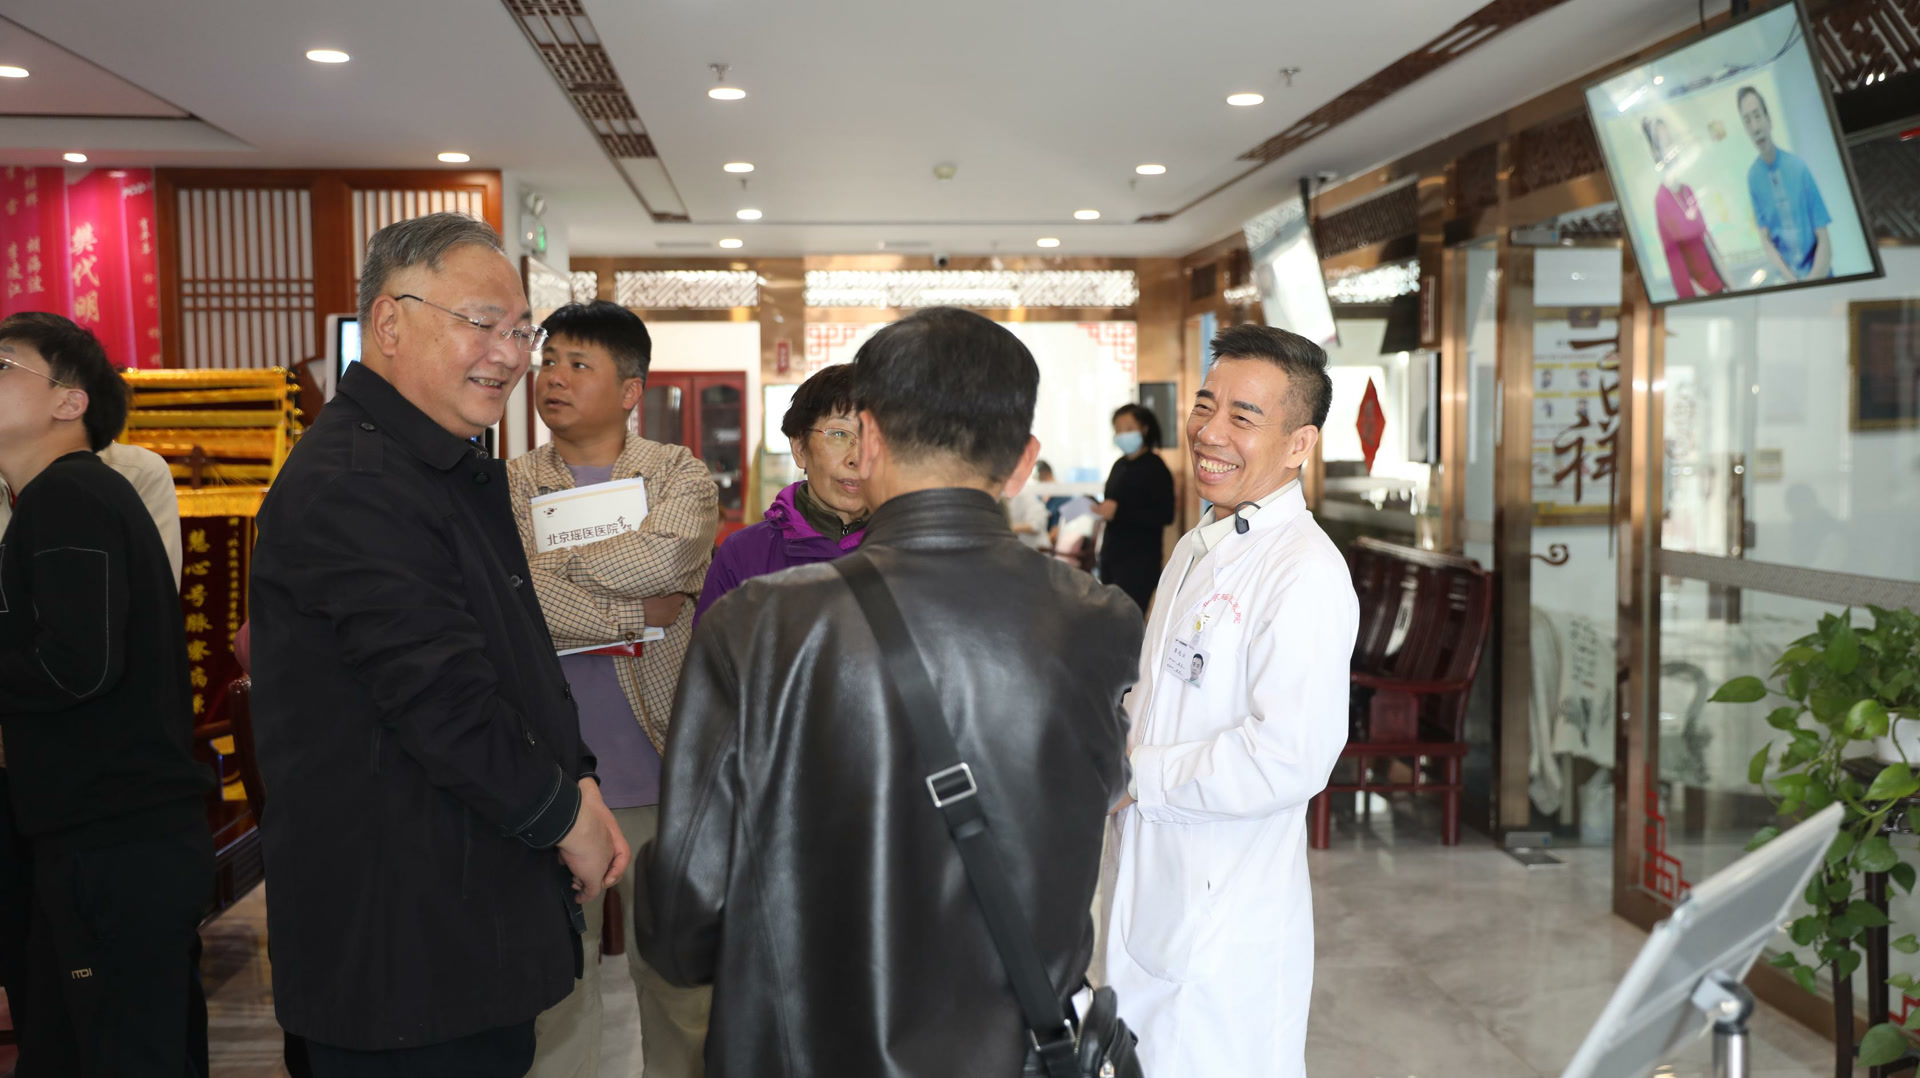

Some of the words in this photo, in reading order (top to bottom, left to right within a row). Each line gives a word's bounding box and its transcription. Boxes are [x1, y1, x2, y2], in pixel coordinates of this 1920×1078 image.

[547, 523, 619, 546] 北京瑶医医院
